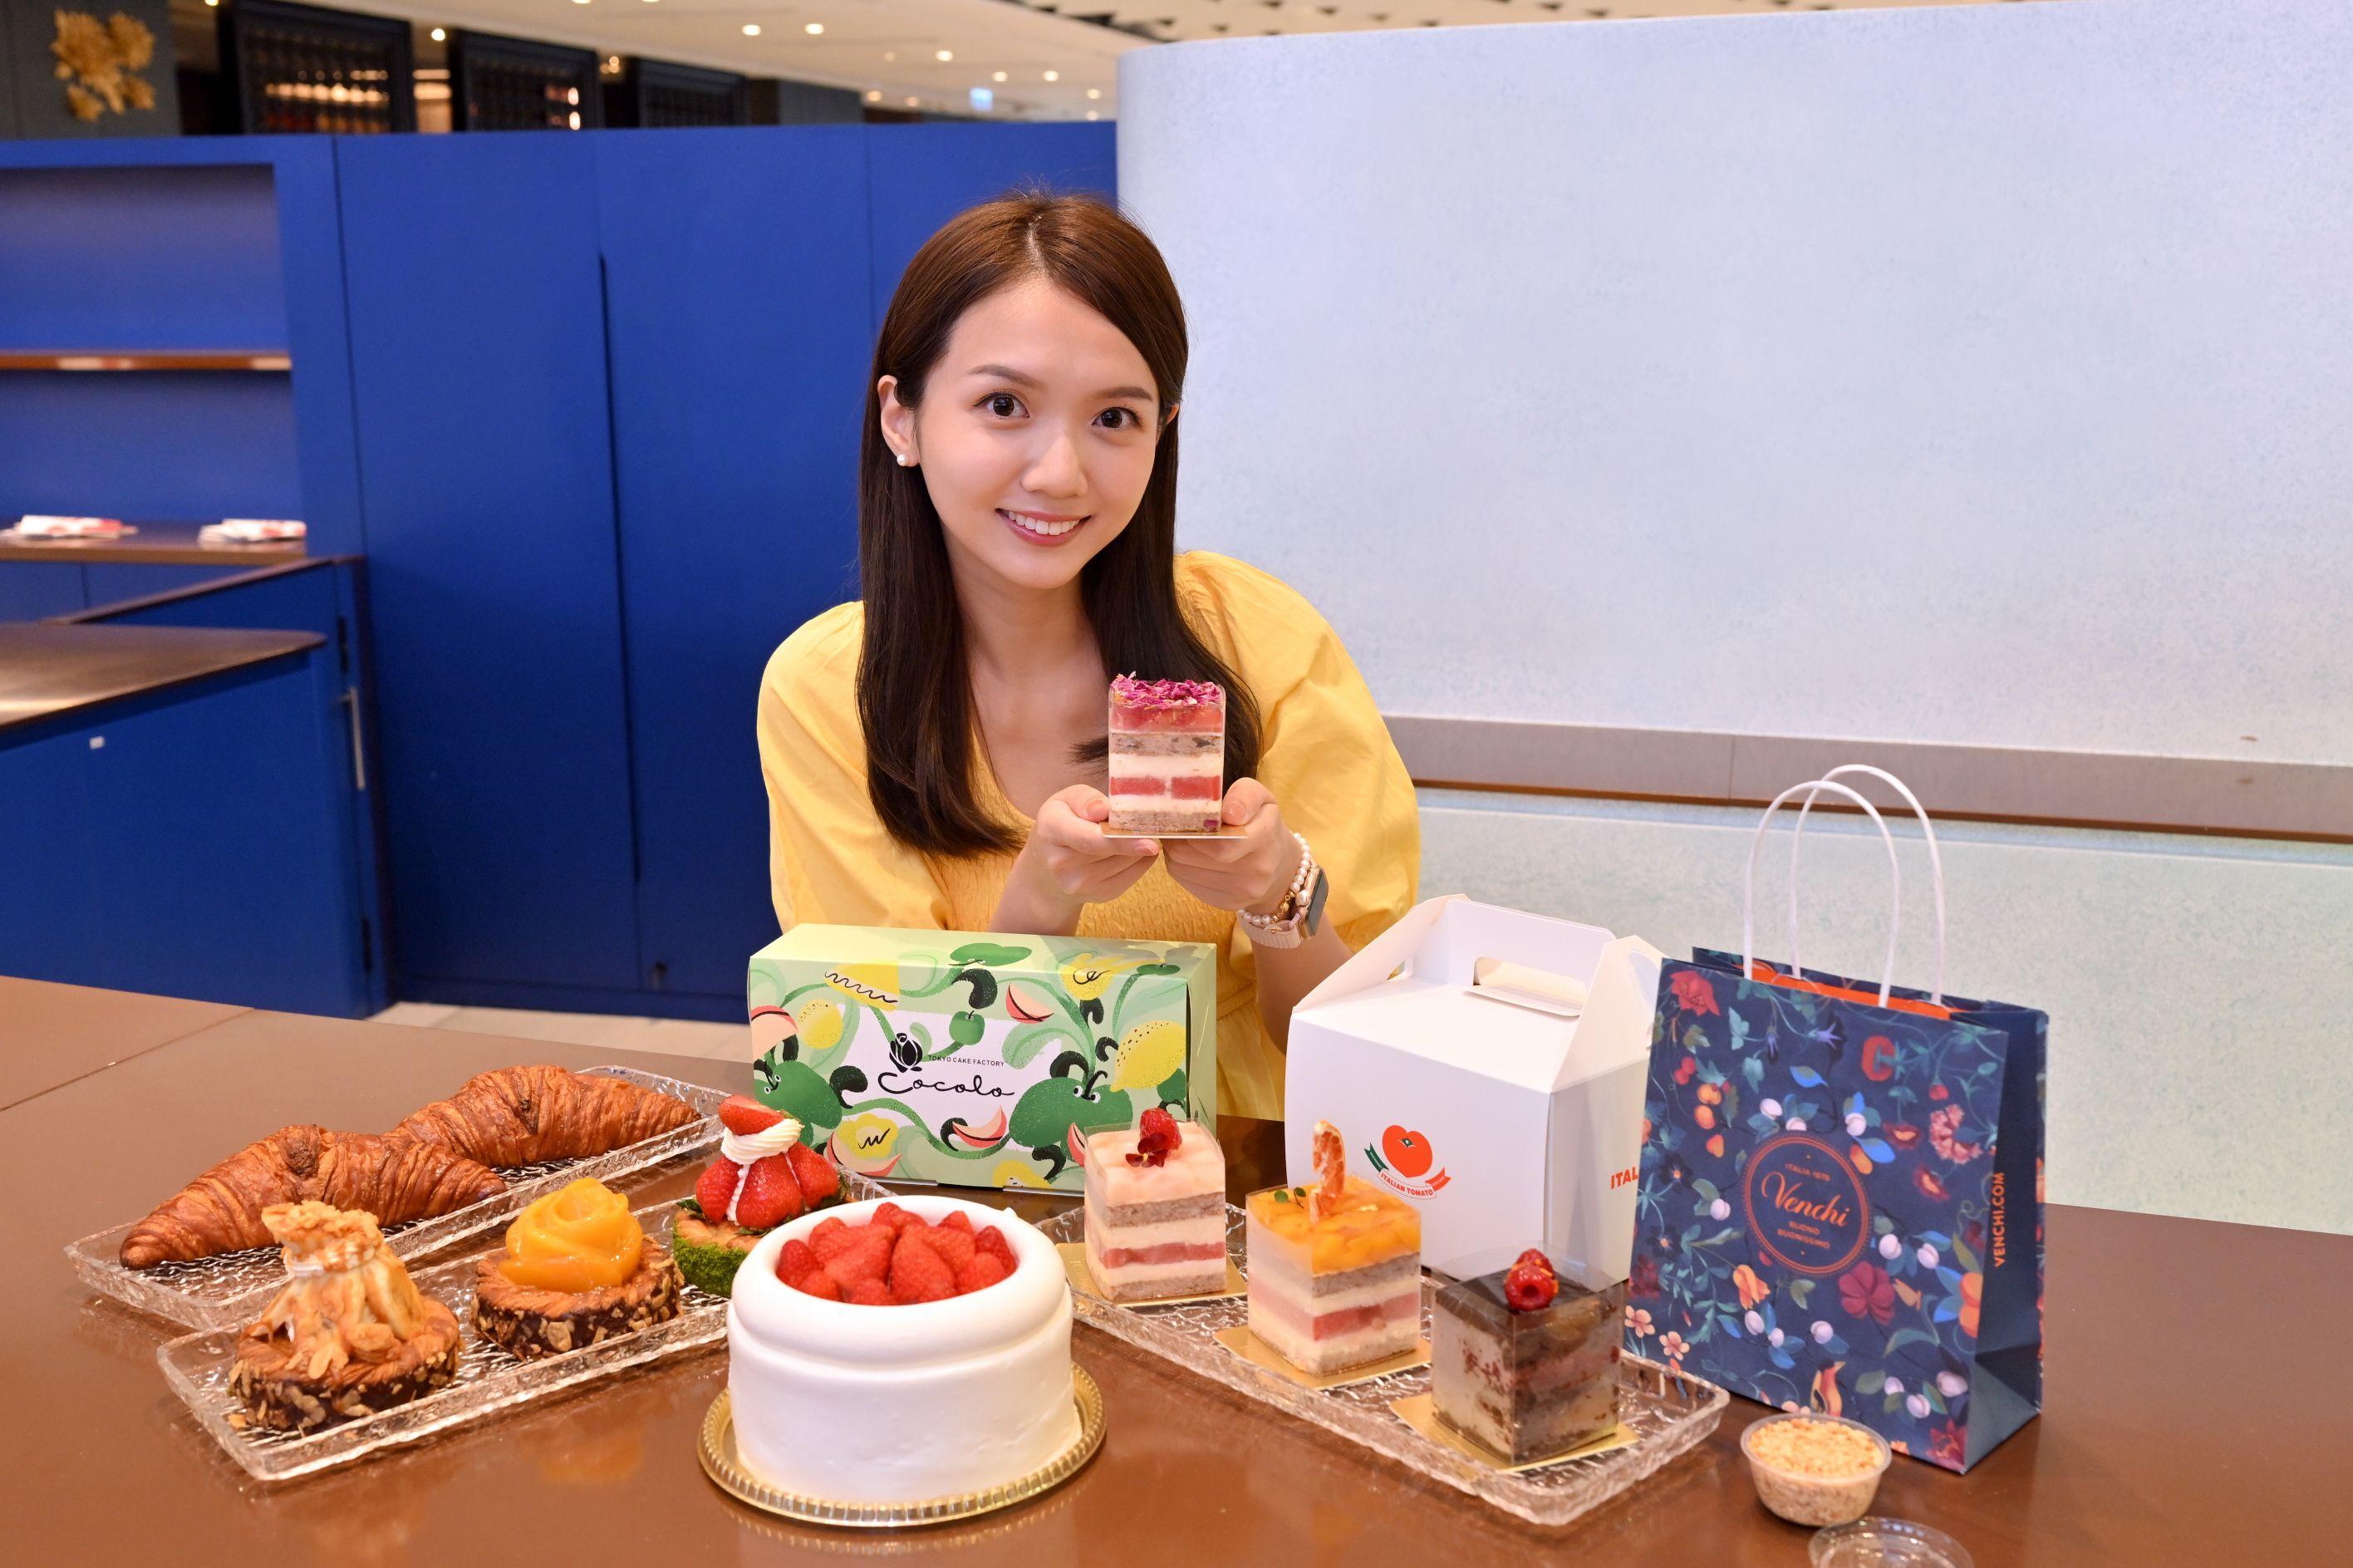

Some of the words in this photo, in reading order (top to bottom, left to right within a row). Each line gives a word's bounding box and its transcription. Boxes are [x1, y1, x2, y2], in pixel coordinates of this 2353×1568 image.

[928, 1054, 951, 1063] TOKYO
[973, 1058, 1005, 1067] FACTORY
[877, 1072, 1015, 1098] Cocolo
[1381, 1172, 1405, 1192] ITALIAN
[1761, 1172, 1850, 1226] Venchi
[1992, 1172, 2006, 1267] VENCHI.COM
